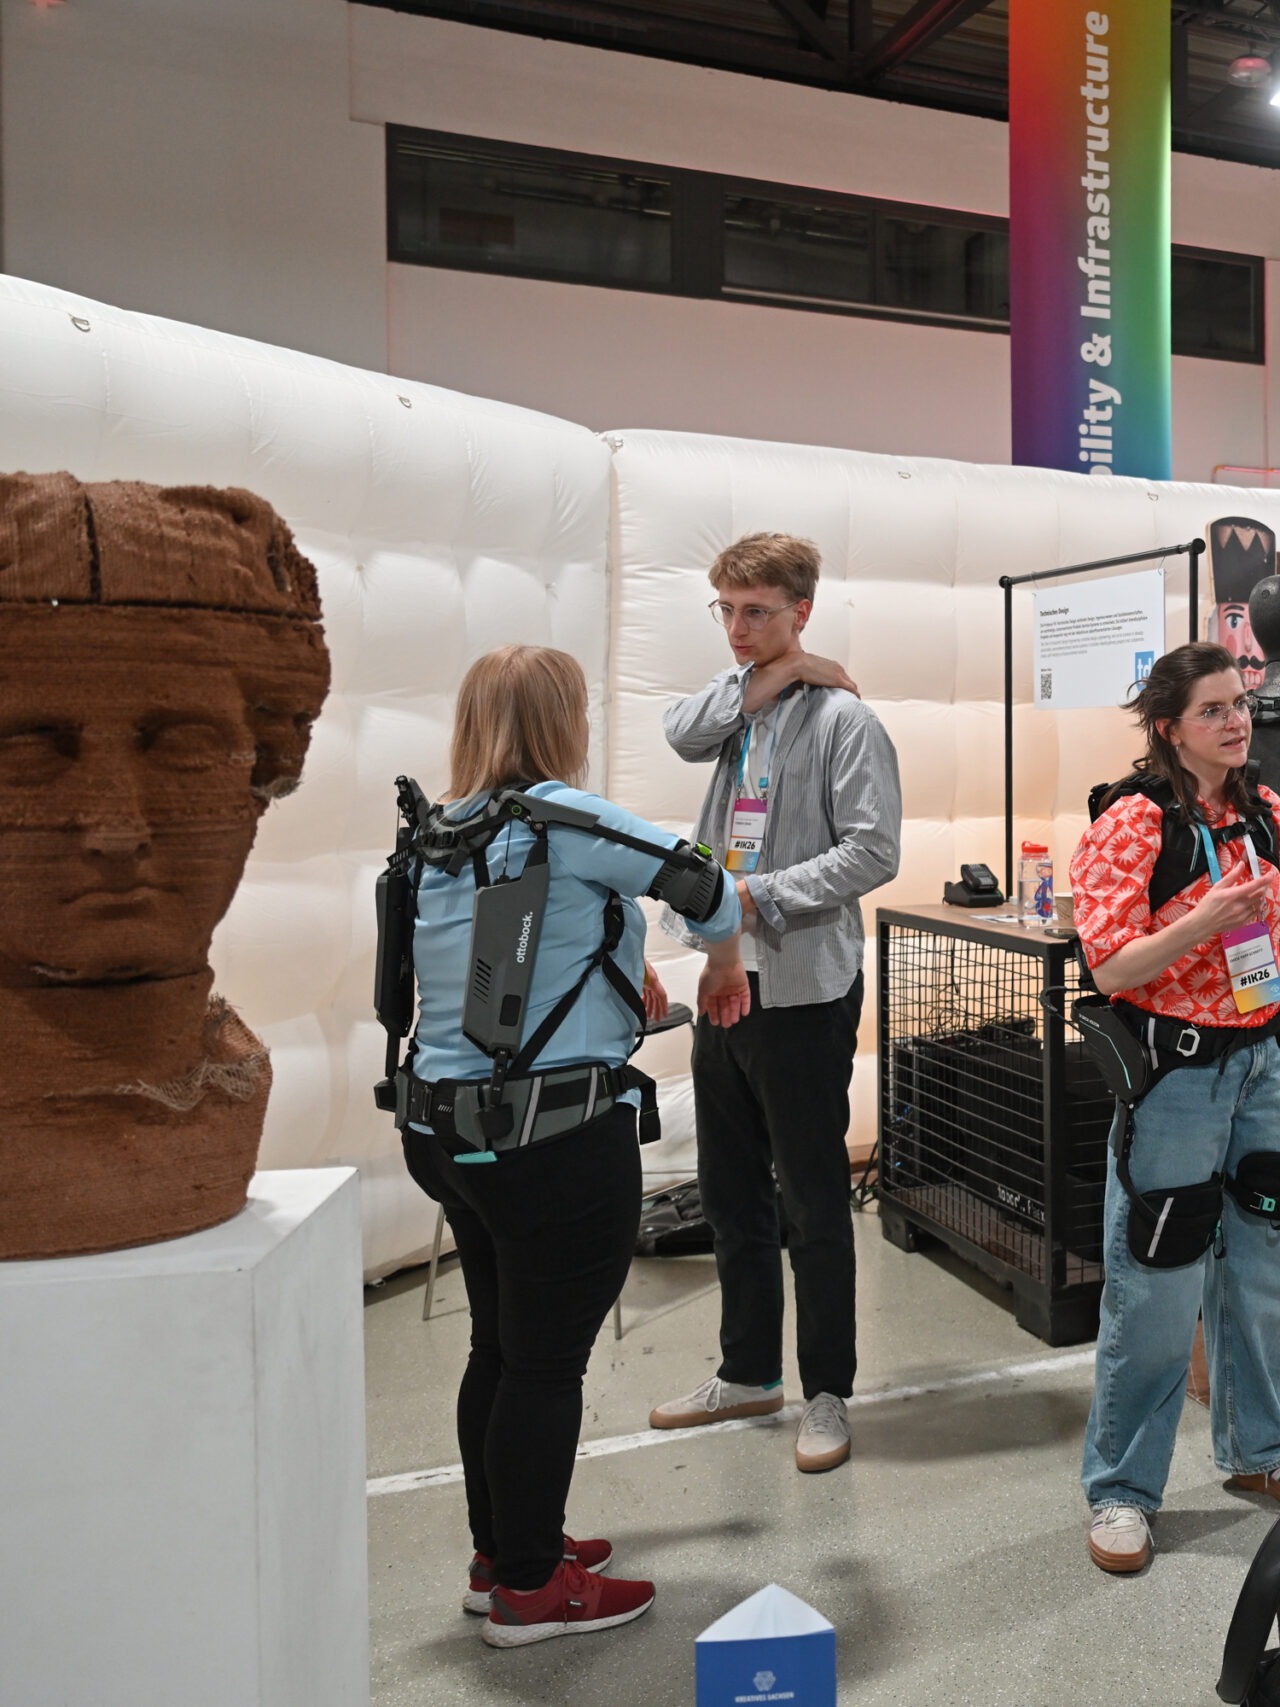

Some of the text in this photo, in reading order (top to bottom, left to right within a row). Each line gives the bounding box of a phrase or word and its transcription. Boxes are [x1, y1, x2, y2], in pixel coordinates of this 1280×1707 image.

[1077, 11, 1111, 319] Infrastructure
[1081, 334, 1112, 366] &
[734, 840, 756, 850] #IK26
[516, 911, 533, 963] ottobock.
[1240, 968, 1270, 987] #IK26
